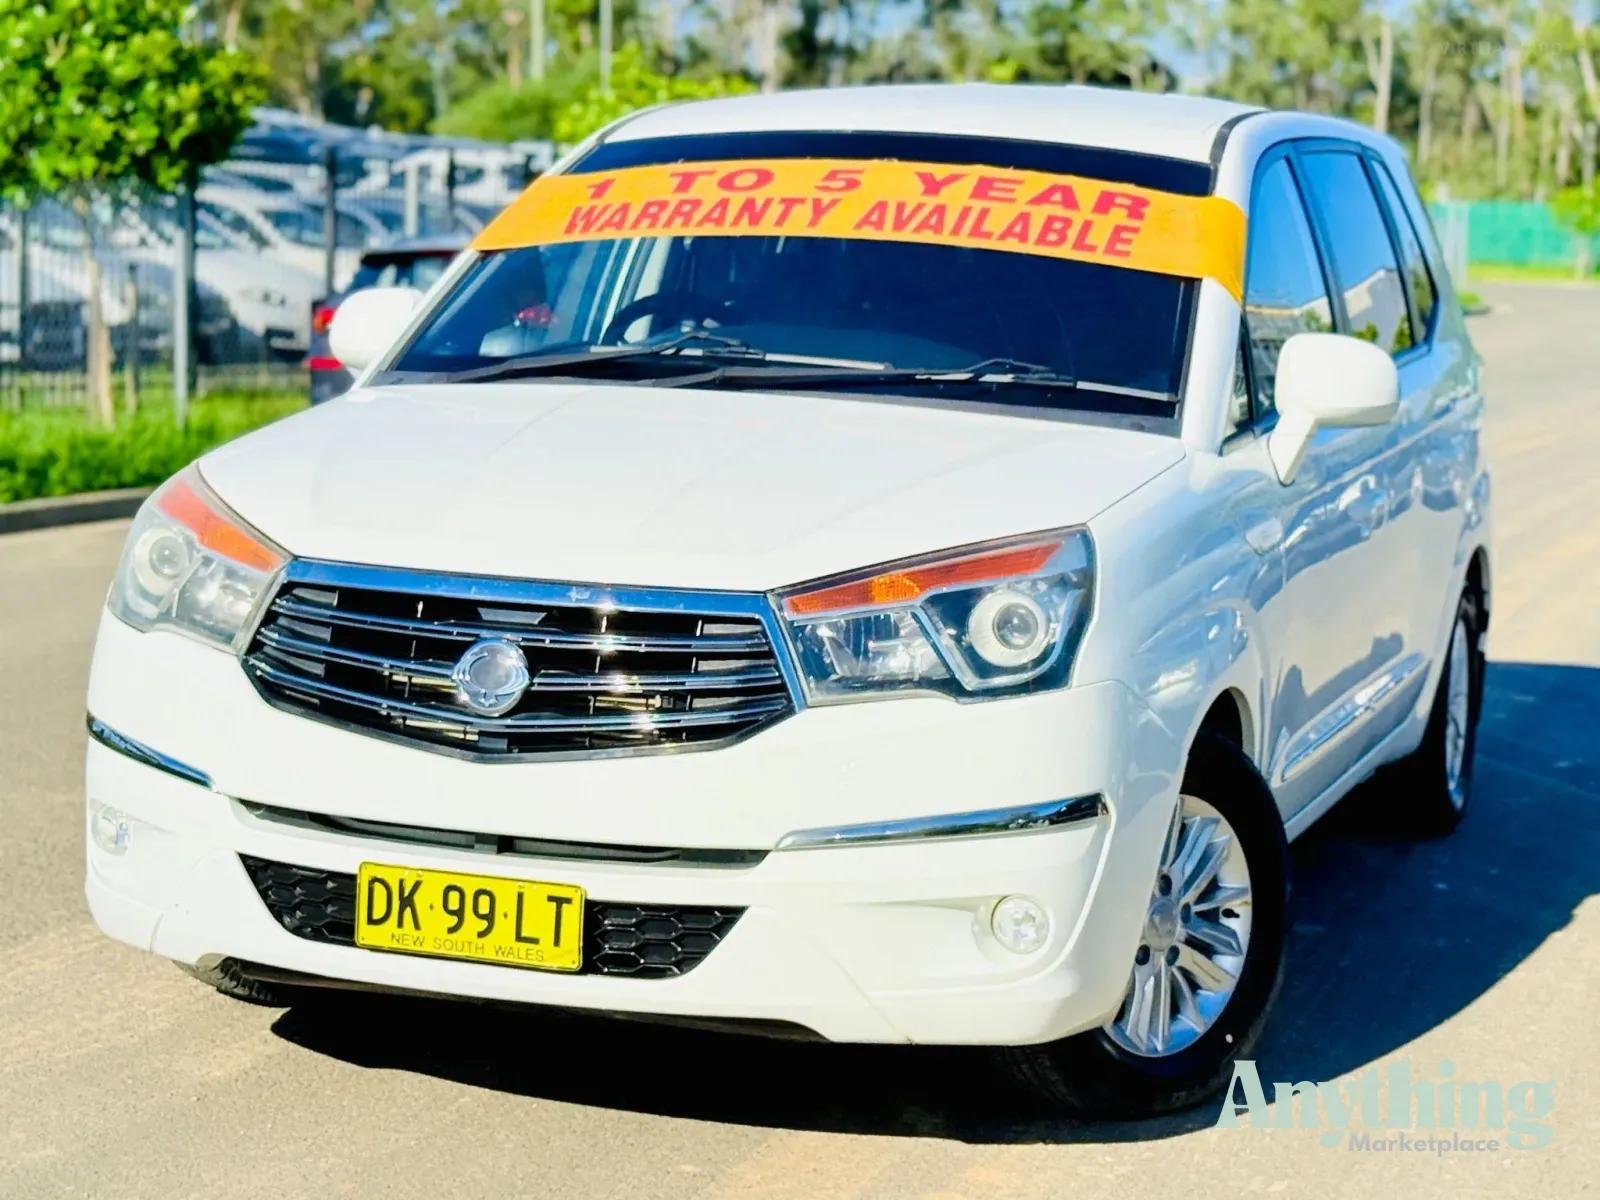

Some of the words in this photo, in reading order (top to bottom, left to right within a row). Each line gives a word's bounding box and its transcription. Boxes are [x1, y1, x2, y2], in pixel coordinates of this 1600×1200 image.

[587, 178, 616, 199] 1
[668, 169, 774, 193] TO
[814, 169, 864, 192] 5
[914, 171, 1151, 221] YEAR
[563, 197, 841, 234] WARRANTY
[853, 201, 1141, 257] AVAILABLE
[390, 932, 425, 947] NEW
[433, 938, 485, 955] SOUTH
[494, 945, 544, 962] WALES
